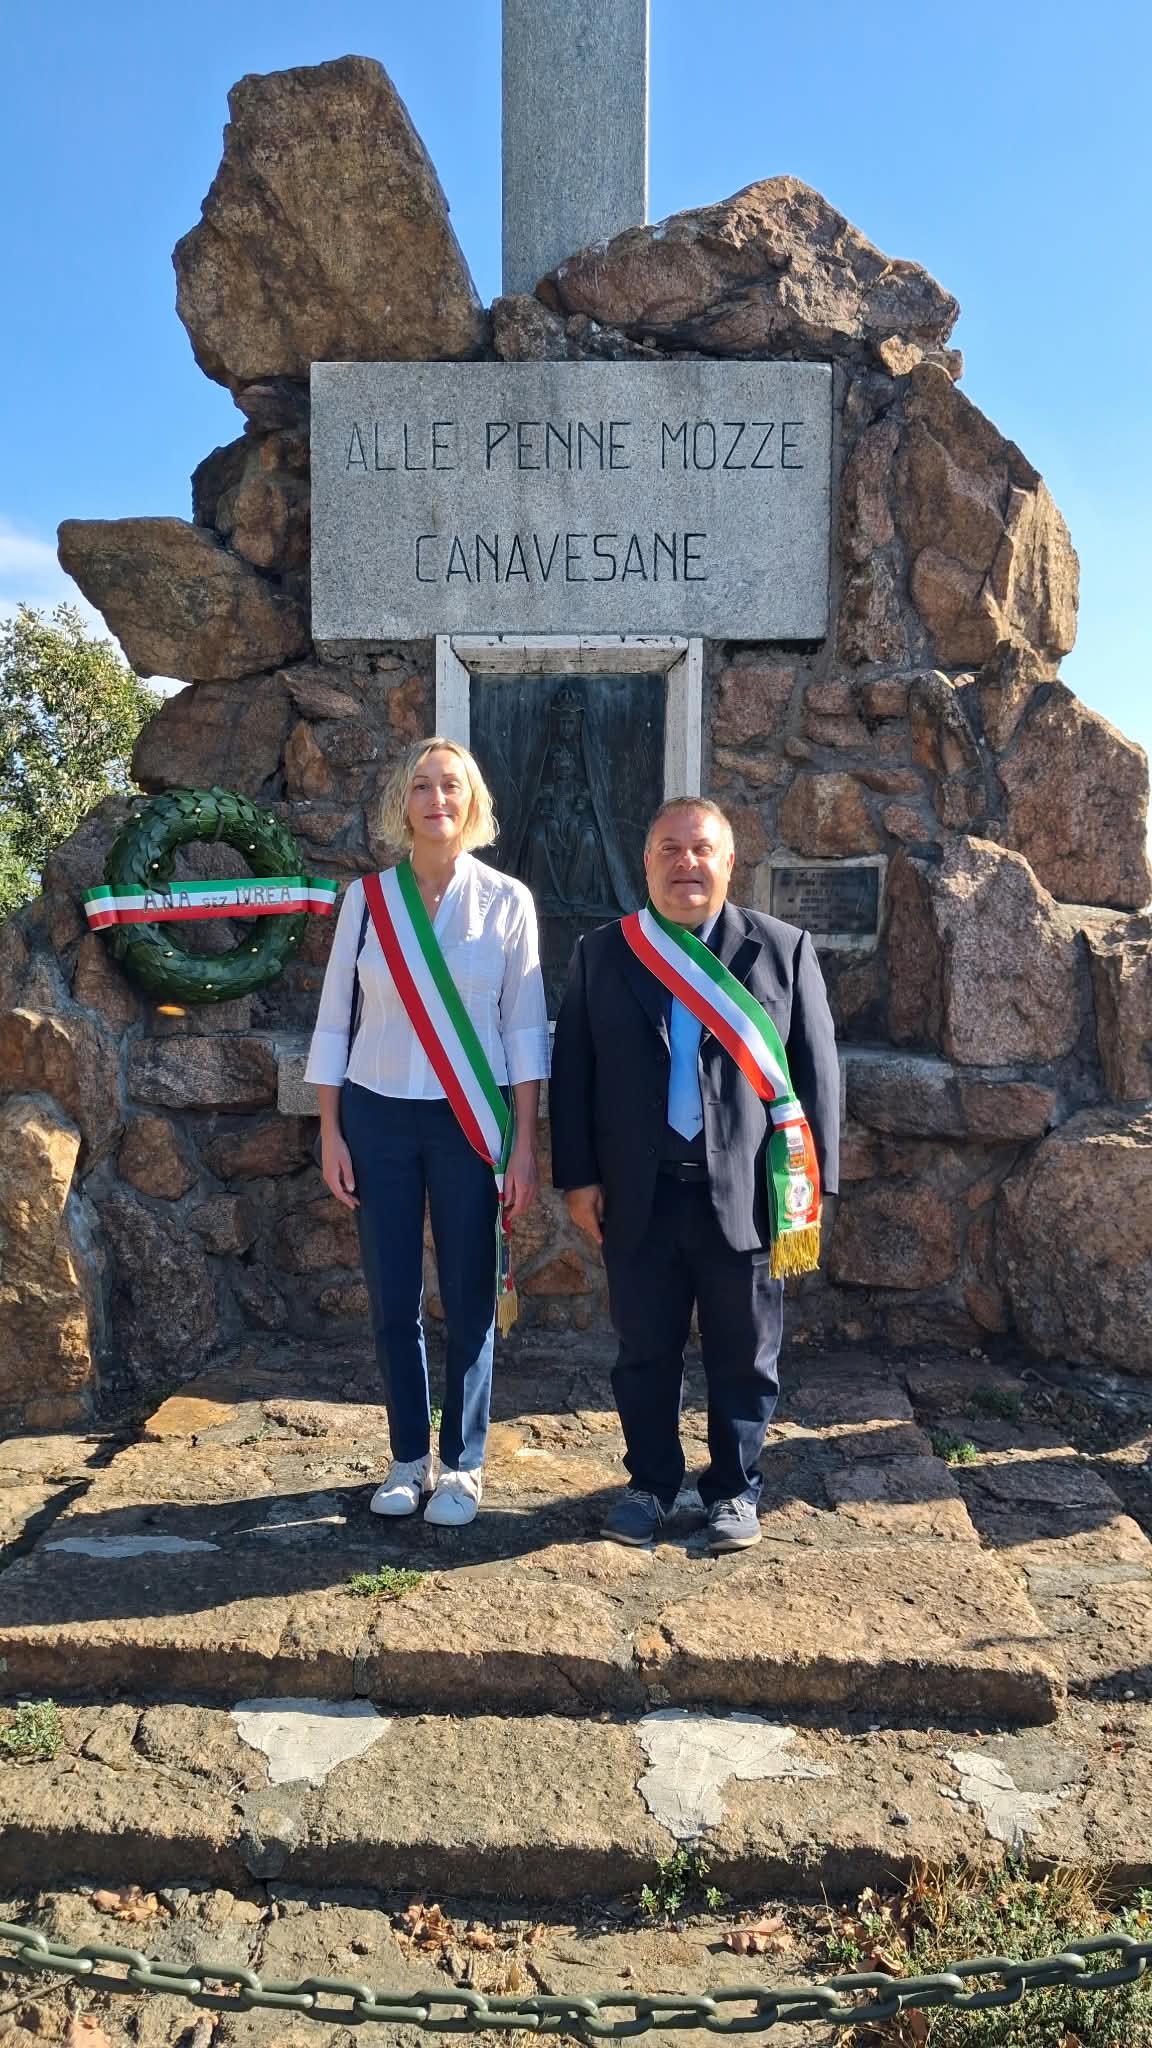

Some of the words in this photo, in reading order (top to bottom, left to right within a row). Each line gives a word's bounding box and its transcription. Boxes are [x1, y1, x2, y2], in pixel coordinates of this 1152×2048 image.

[346, 422, 454, 471] ALLE
[485, 421, 631, 470] PENNE
[661, 421, 804, 470] MOZZE
[415, 533, 707, 583] CANAVESANE
[143, 891, 192, 913] ANA
[235, 886, 293, 906] IVREA
